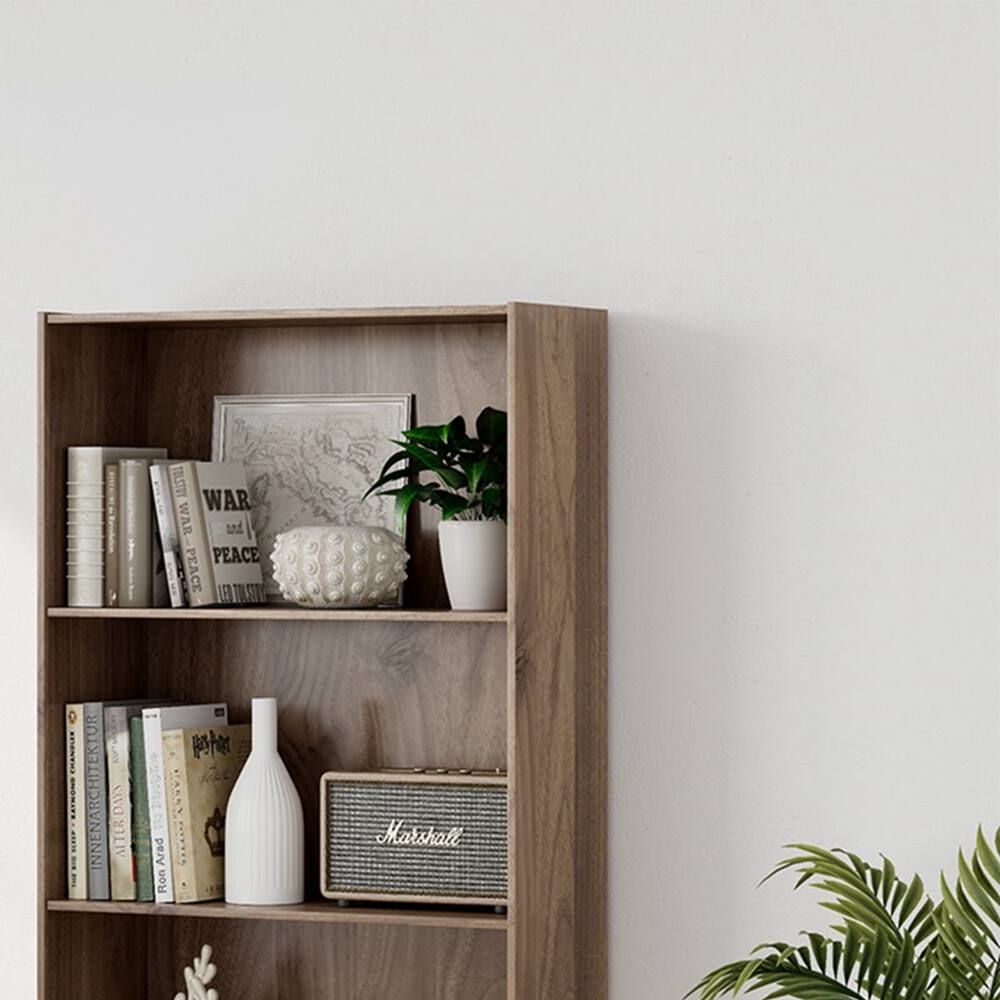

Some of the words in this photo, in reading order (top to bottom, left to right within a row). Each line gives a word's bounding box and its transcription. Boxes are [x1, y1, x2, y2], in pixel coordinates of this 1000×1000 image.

[202, 489, 252, 512] WAR
[226, 521, 244, 535] and
[179, 502, 193, 536] WAR
[186, 547, 202, 593] PEACE
[212, 546, 260, 564] PEACE
[86, 714, 103, 870] INNENARCHITEKTUR
[376, 818, 464, 847] Marshall
[155, 838, 165, 866] Arad
[157, 869, 167, 894] Ron
